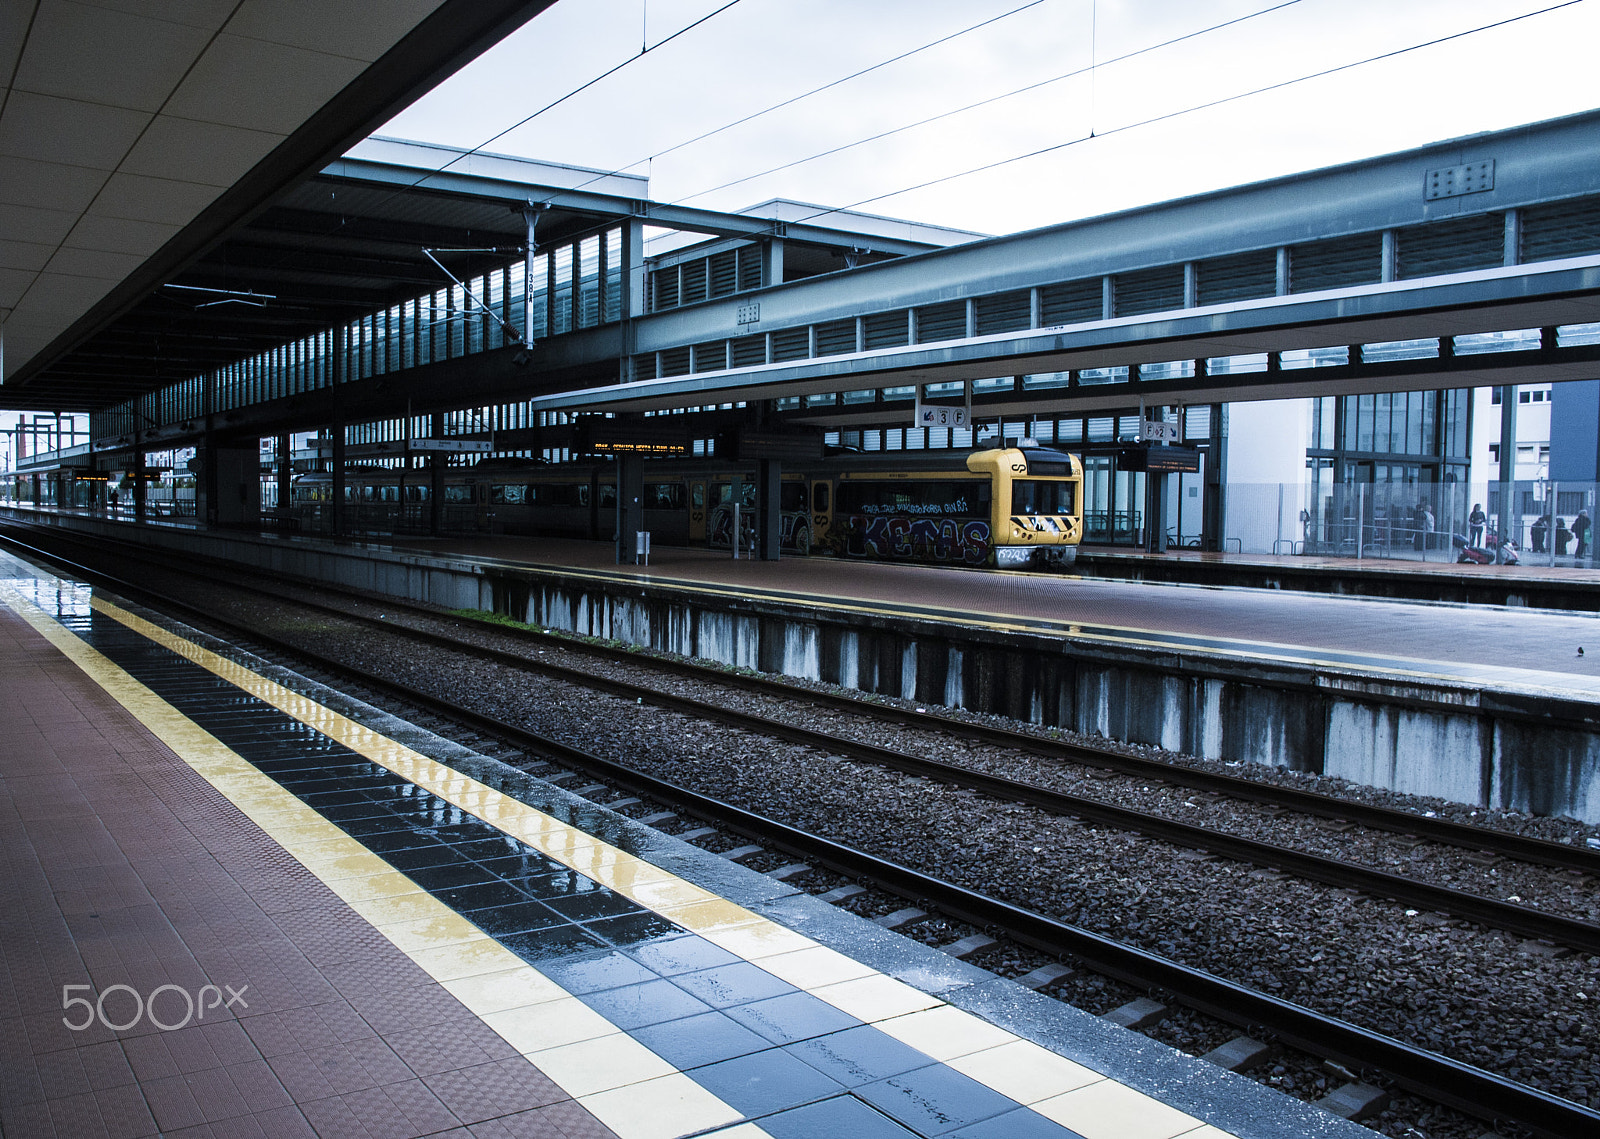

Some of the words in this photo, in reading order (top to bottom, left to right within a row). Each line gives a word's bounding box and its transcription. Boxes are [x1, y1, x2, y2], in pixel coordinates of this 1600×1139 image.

[941, 413, 947, 424] 3
[956, 412, 963, 423] F
[1147, 426, 1152, 435] F
[1159, 428, 1164, 438] 2
